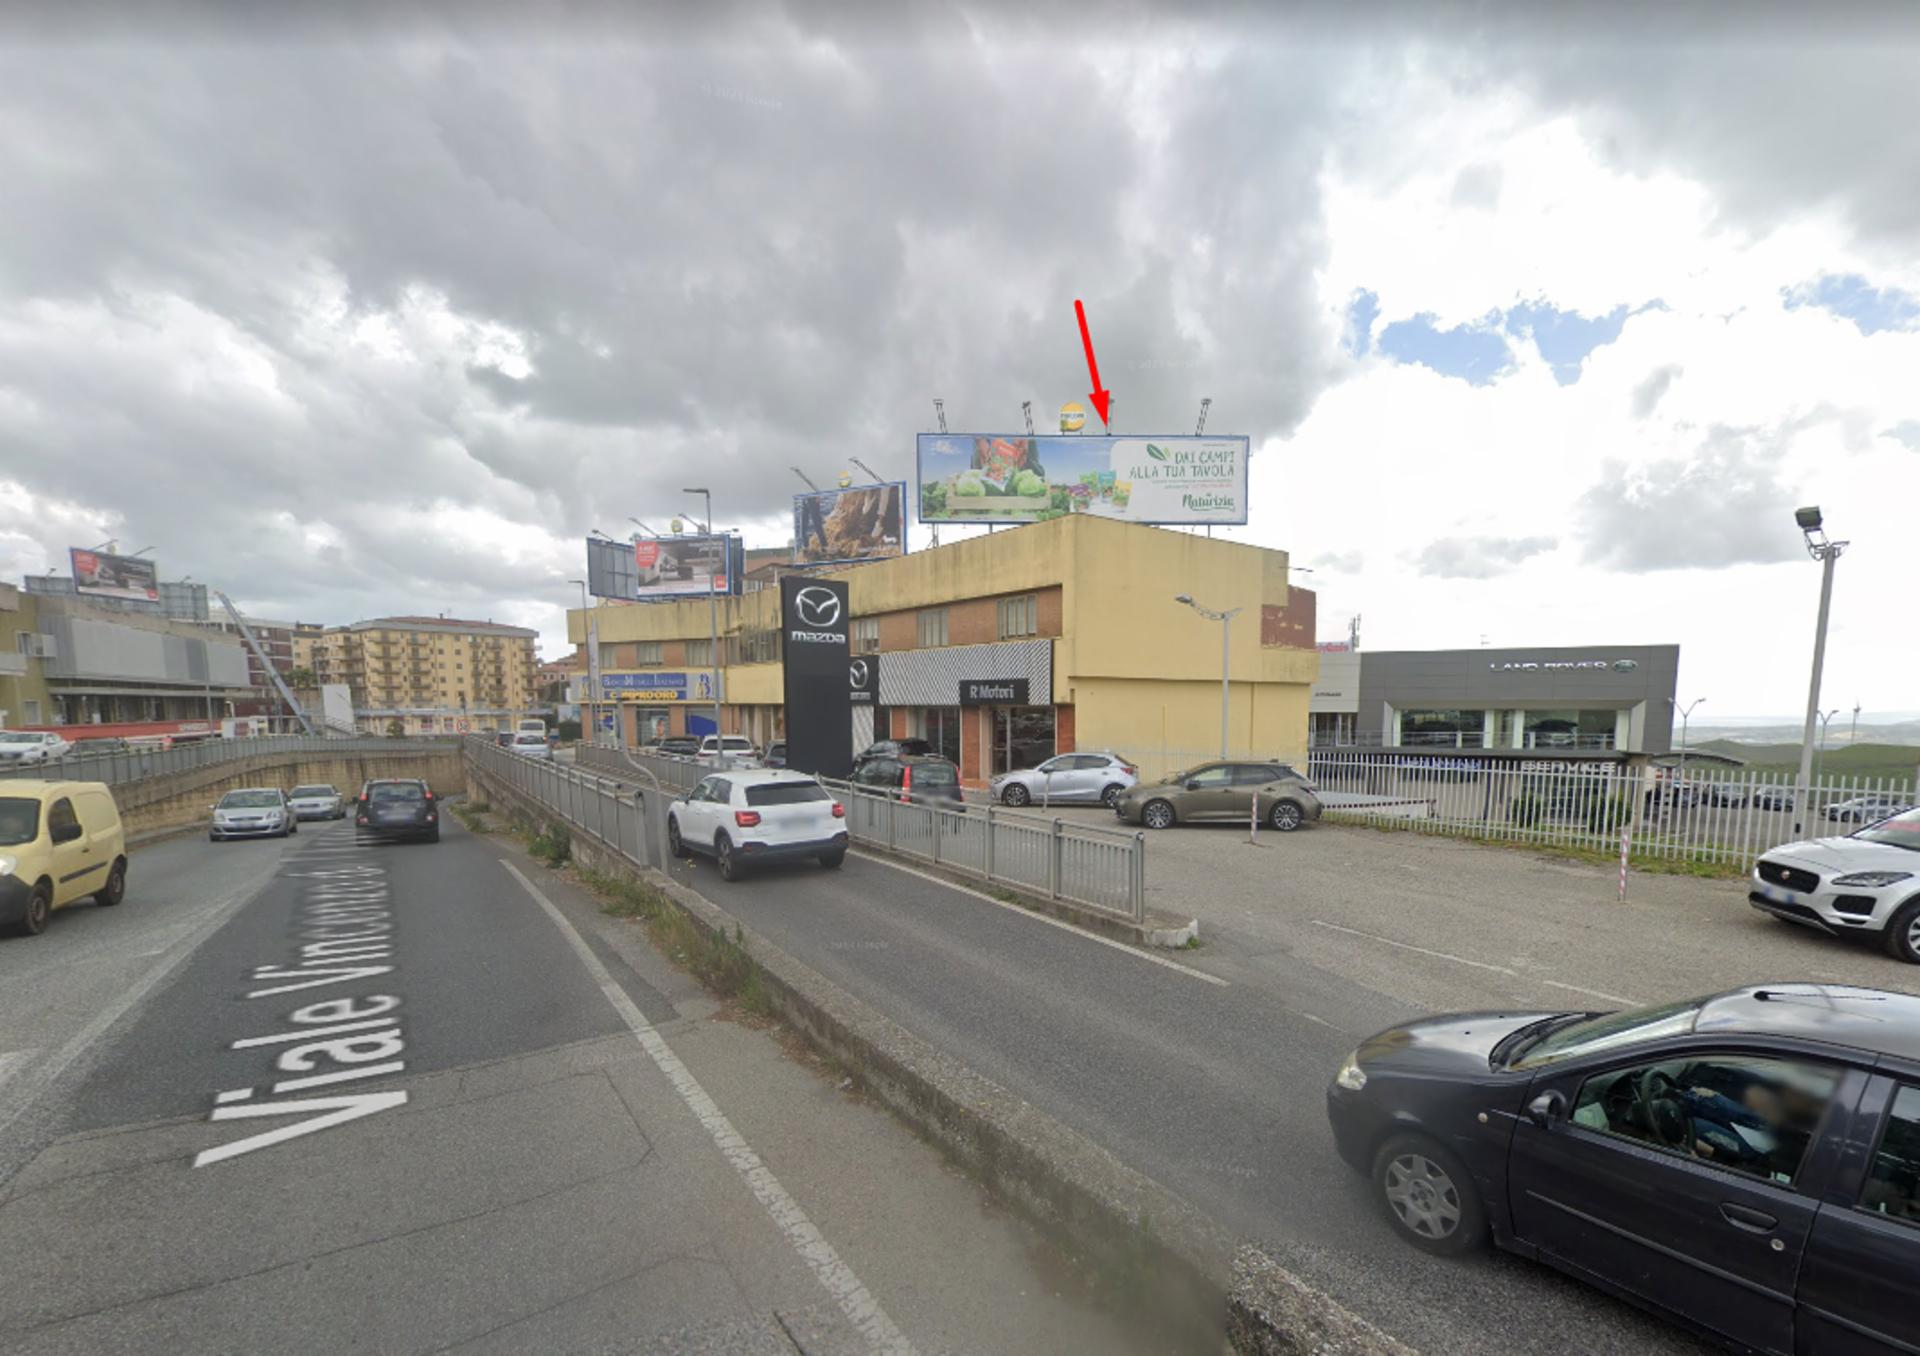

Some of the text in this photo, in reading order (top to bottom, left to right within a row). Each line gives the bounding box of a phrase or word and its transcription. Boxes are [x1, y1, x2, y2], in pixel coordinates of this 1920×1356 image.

[1174, 451, 1235, 464] DAI CAMPI
[1129, 465, 1235, 479] ALLA TUA TAVOLA
[792, 630, 846, 644] mazda
[1490, 660, 1608, 672] LAND ROVER
[970, 684, 1015, 699] R Motori
[193, 993, 408, 1168] Viale
